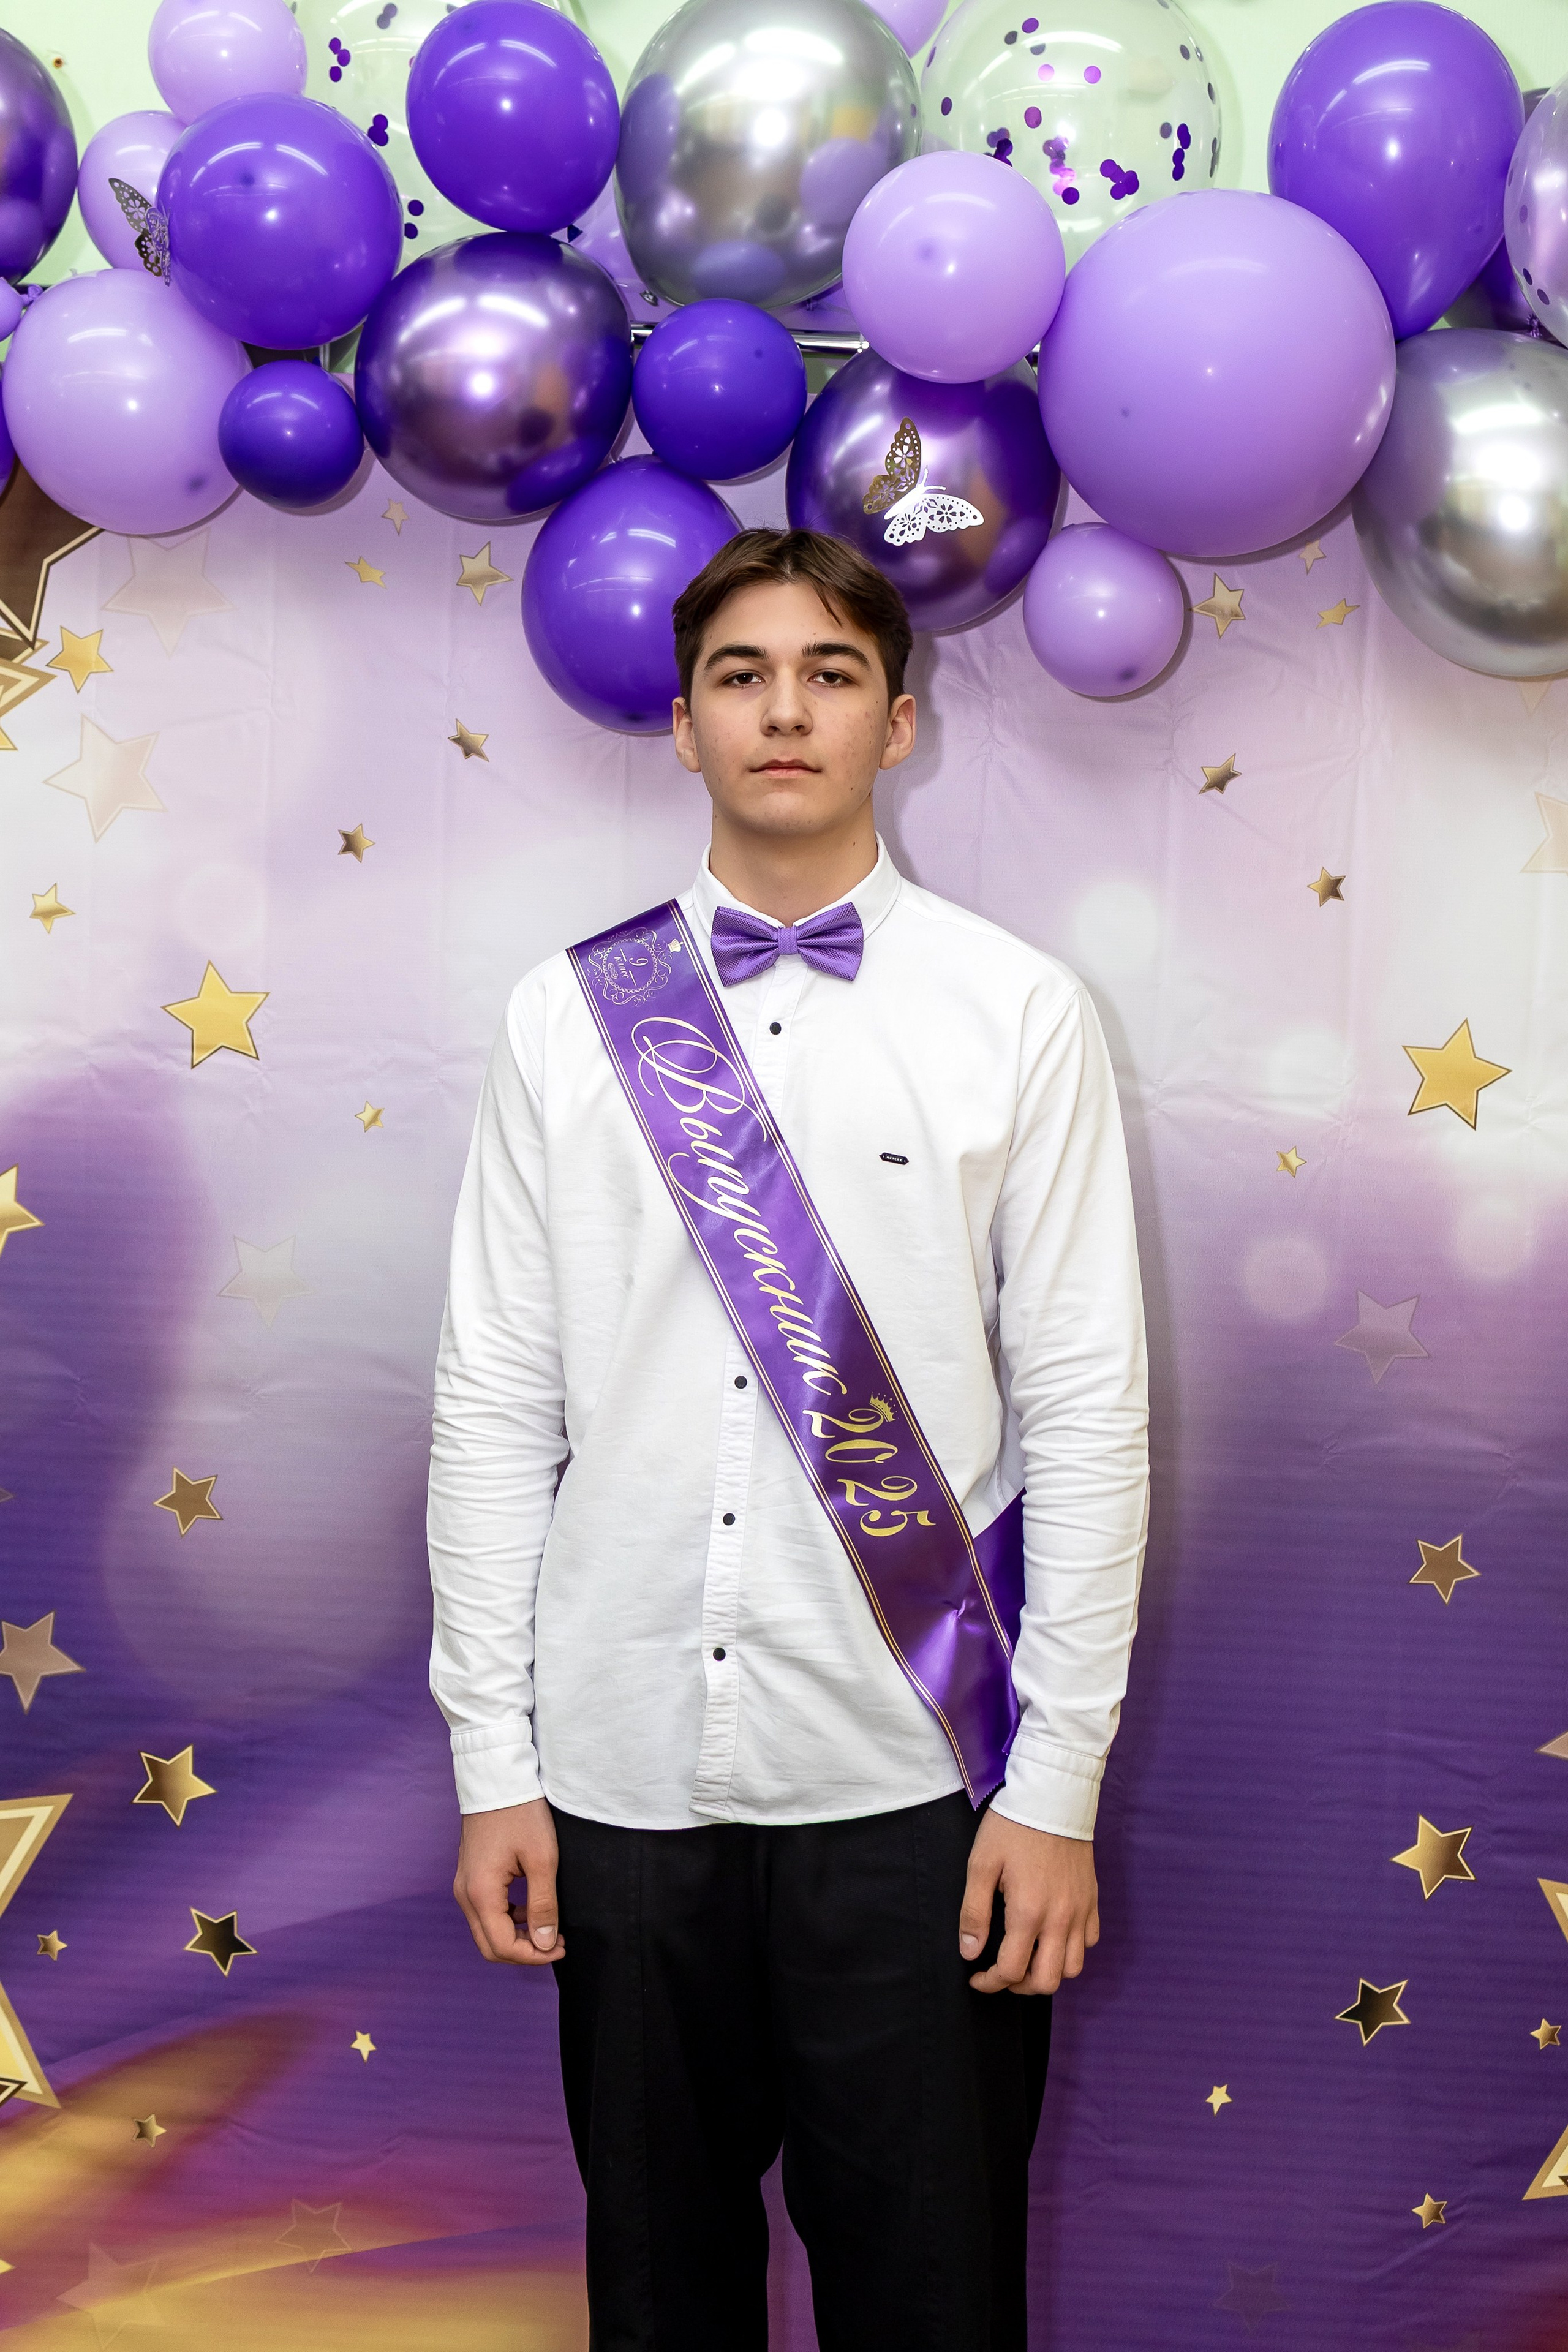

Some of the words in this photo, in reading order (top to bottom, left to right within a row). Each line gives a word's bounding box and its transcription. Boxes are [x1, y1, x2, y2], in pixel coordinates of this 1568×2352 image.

[628, 957, 649, 967] 9
[631, 1017, 847, 1395] Выпускник
[802, 1408, 936, 1537] 2025
